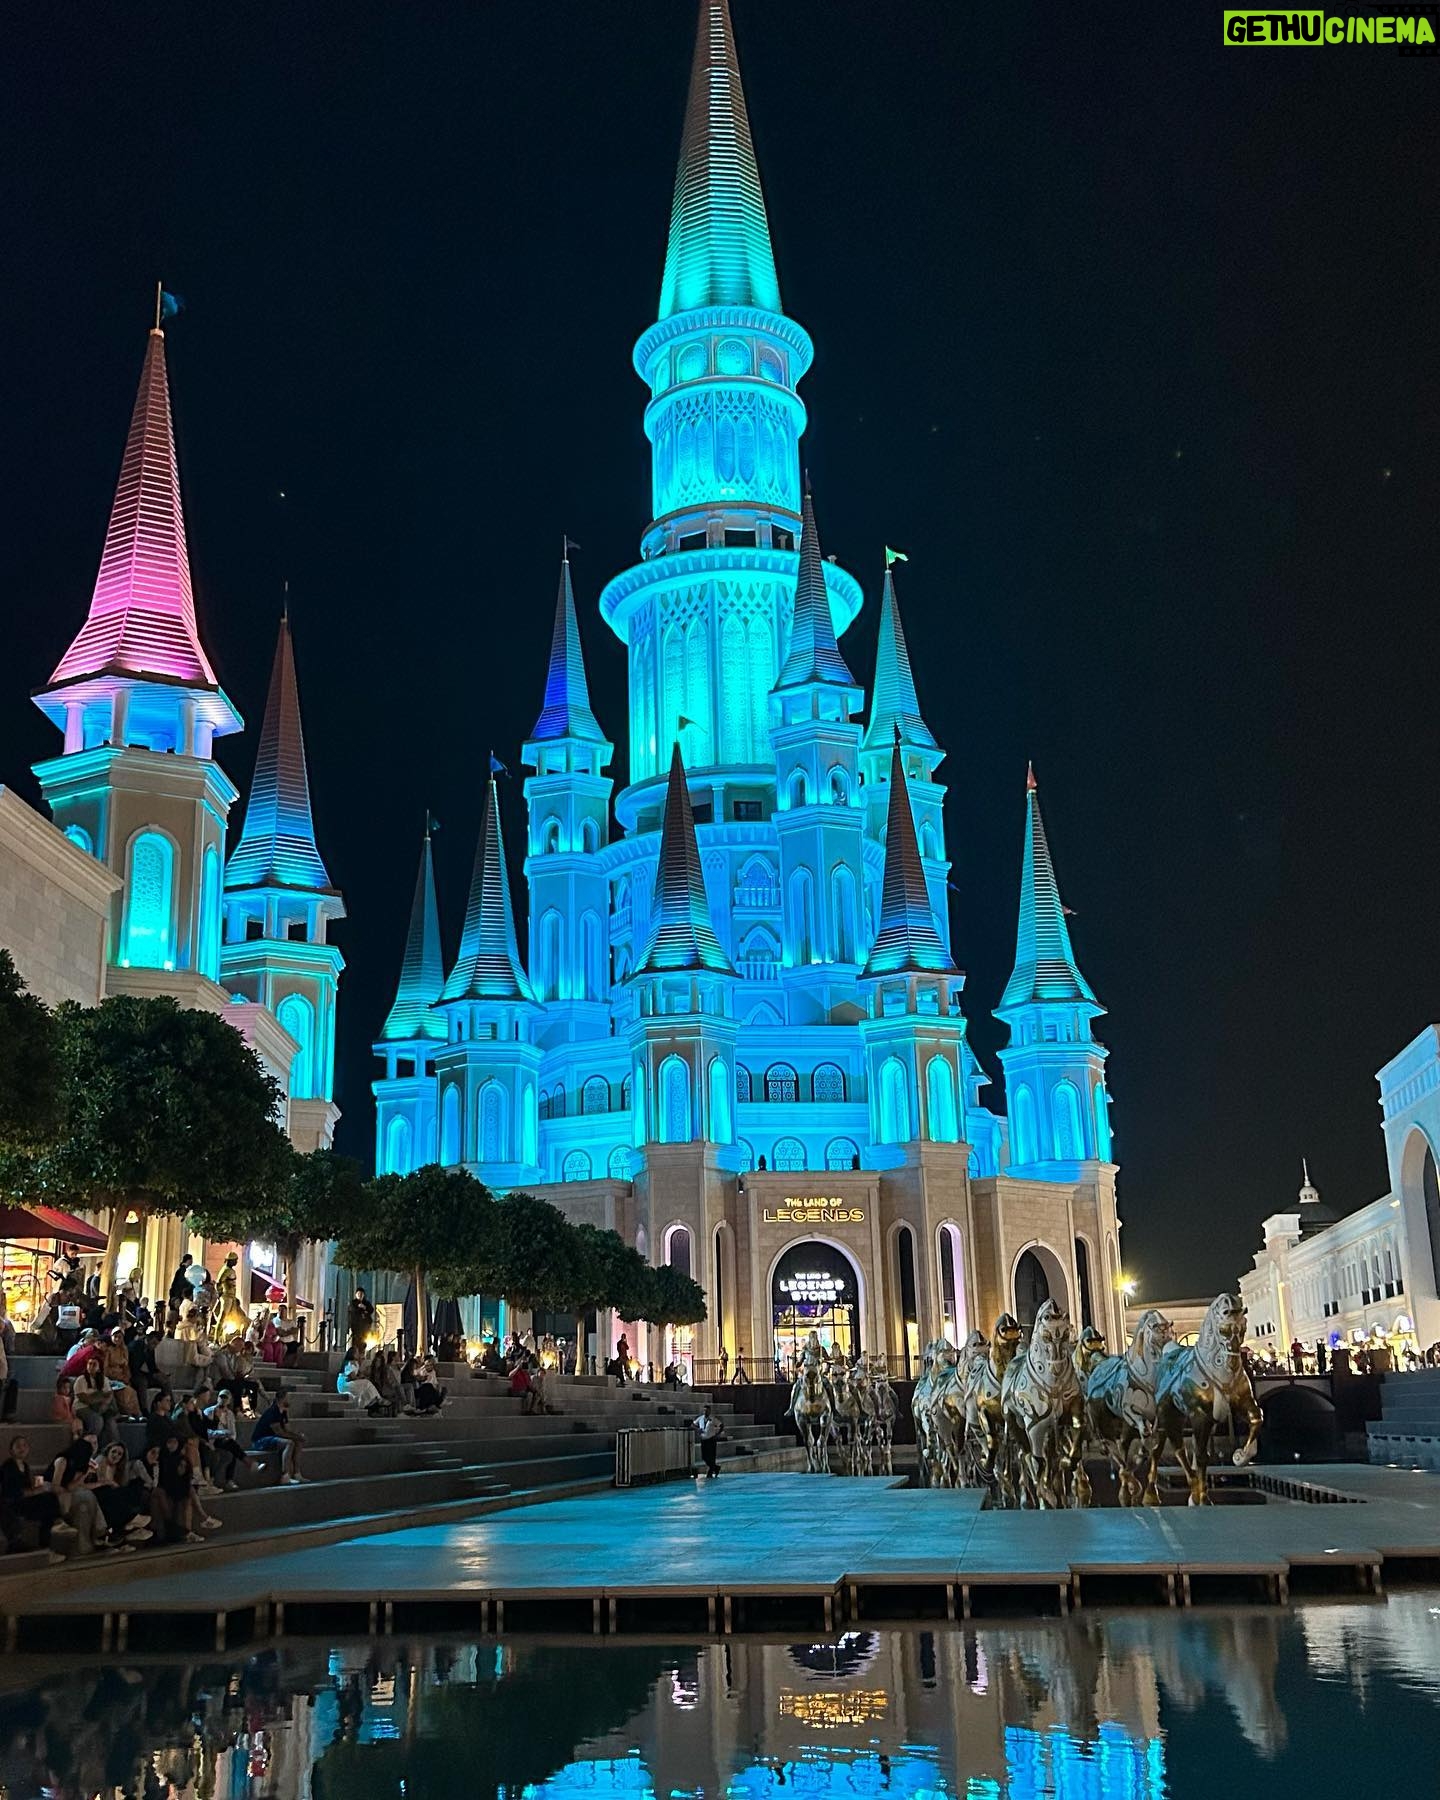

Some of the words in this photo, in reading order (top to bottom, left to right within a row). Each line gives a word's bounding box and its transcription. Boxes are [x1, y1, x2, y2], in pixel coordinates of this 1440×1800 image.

[784, 1198, 802, 1207] THE
[804, 1198, 828, 1207] LAND
[829, 1198, 843, 1207] OF
[763, 1208, 865, 1223] LEGENDS
[779, 1280, 845, 1291] LEGENDS
[791, 1291, 837, 1301] STORE
